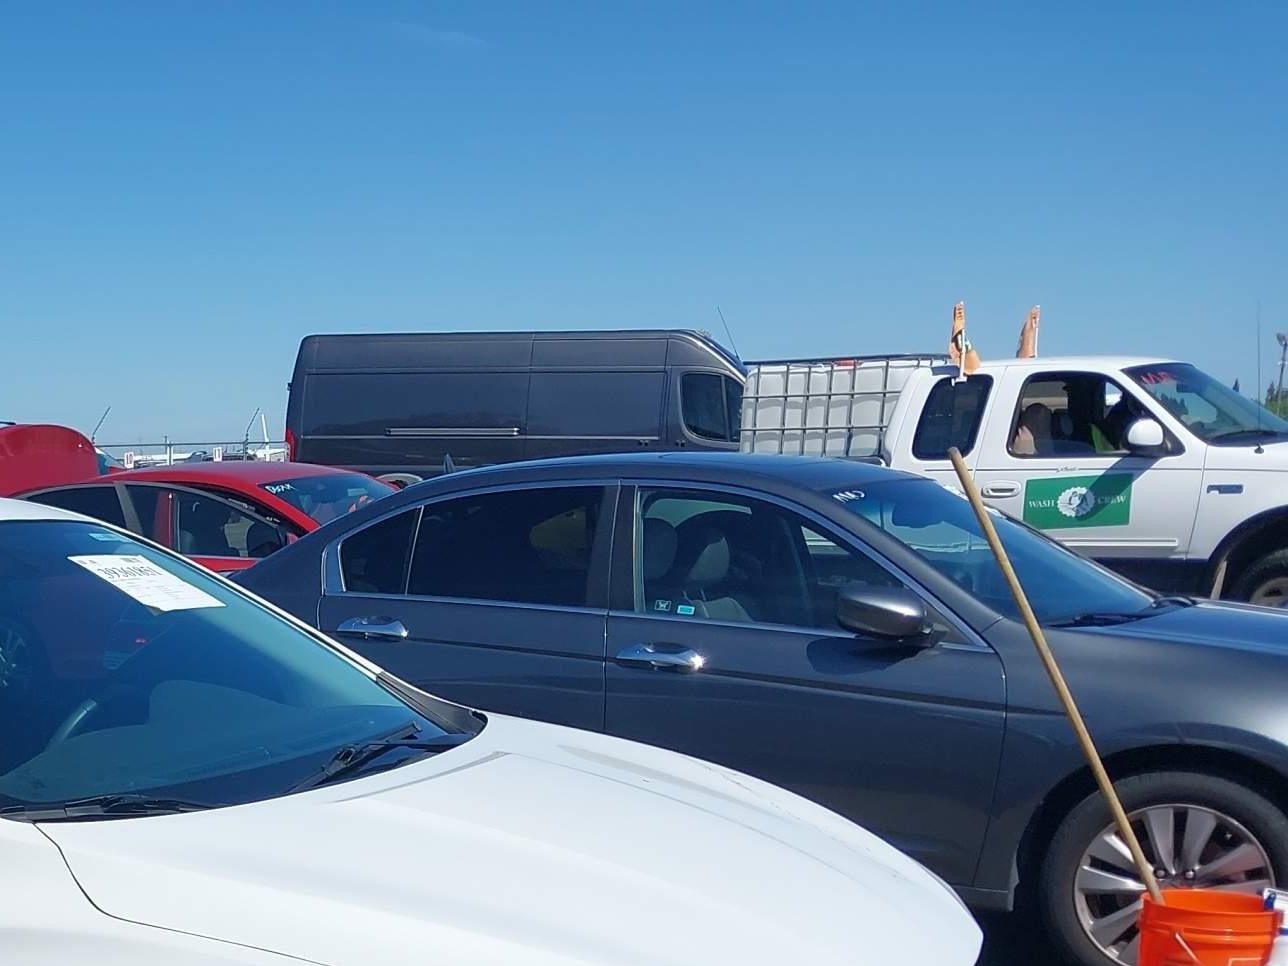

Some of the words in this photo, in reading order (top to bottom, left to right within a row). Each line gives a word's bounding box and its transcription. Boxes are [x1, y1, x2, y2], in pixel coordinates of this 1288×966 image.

[1028, 499, 1055, 508] WASH
[1097, 495, 1127, 505] CREW
[97, 565, 164, 579] 39361851
